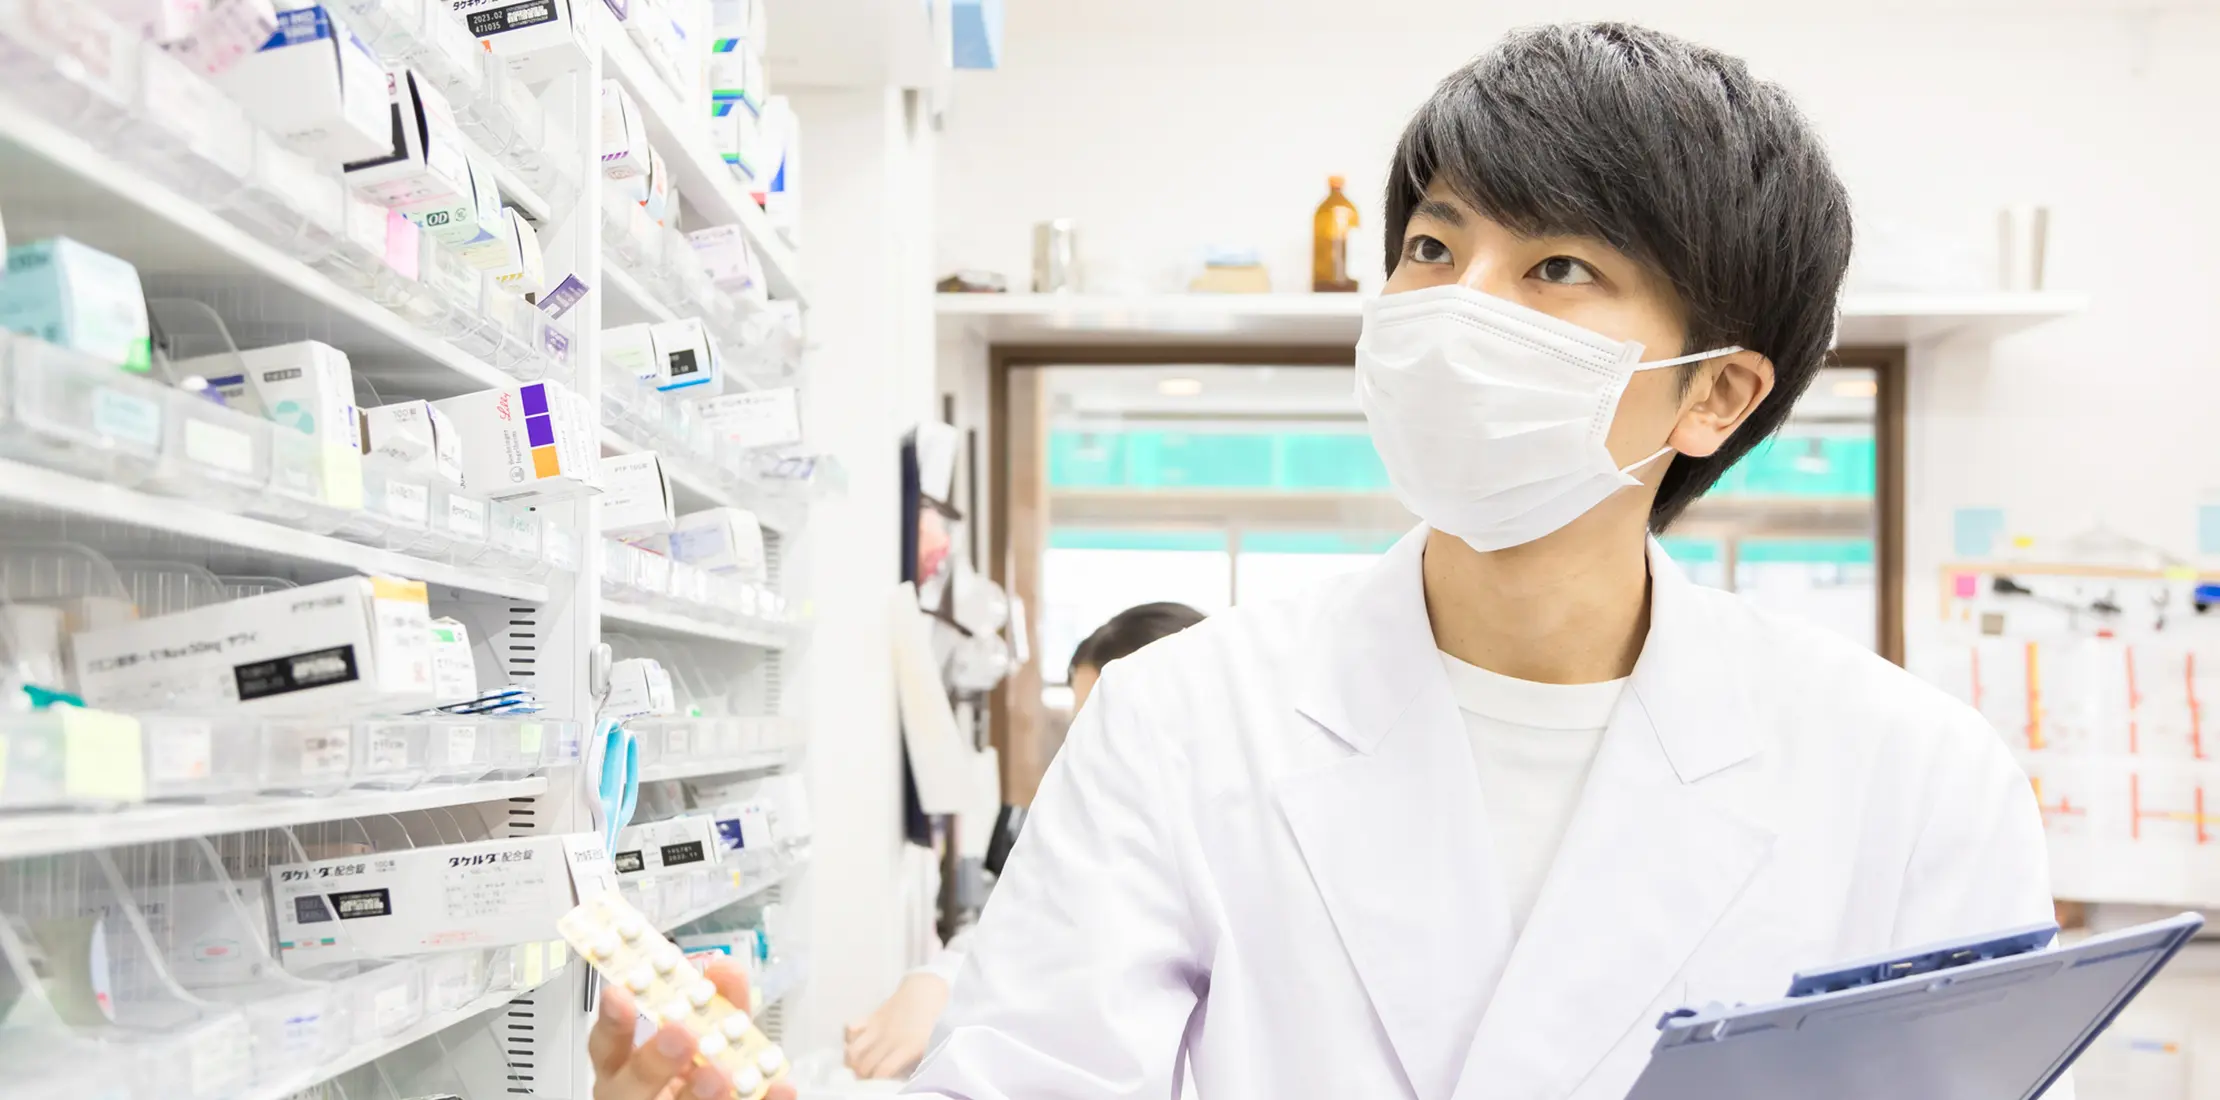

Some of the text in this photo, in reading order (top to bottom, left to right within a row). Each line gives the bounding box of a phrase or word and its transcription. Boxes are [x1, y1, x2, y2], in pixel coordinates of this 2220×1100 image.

[473, 11, 503, 24] 2023.02
[475, 22, 501, 33] 471035
[428, 213, 448, 227] OD
[497, 392, 512, 421] Lilly
